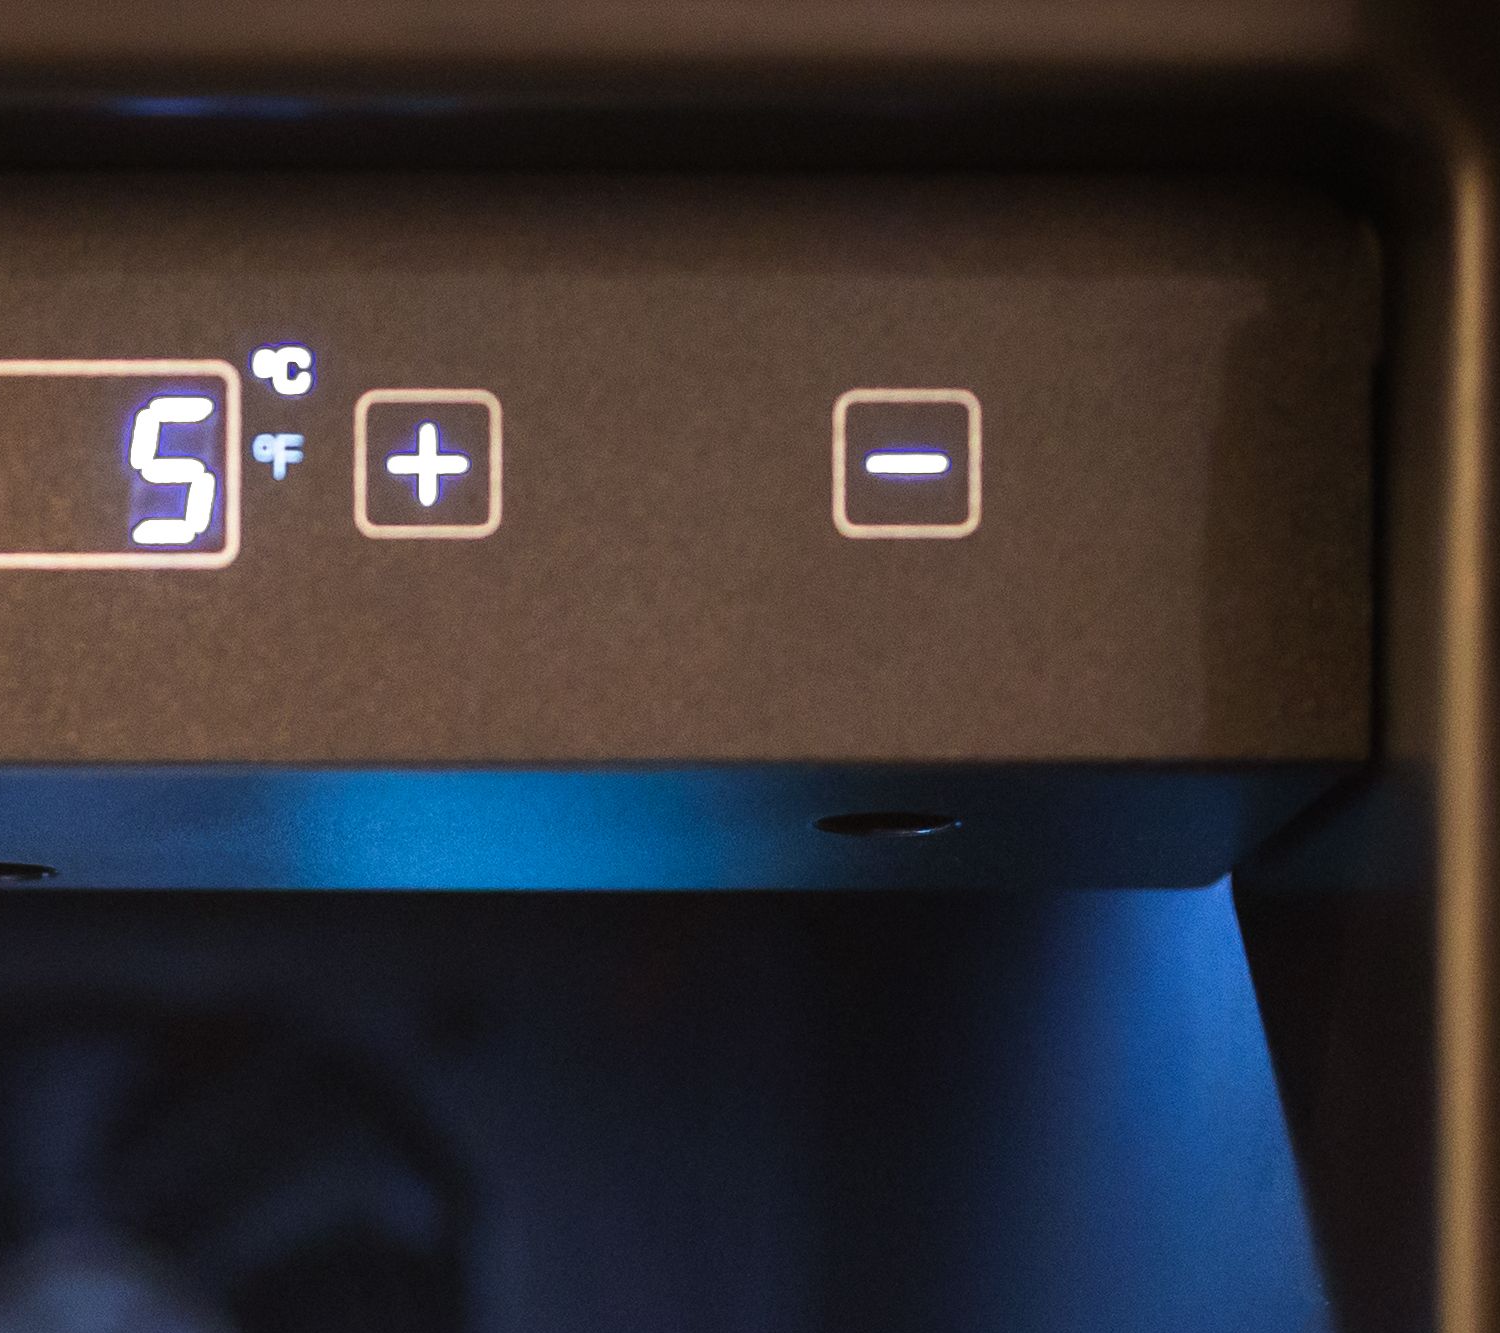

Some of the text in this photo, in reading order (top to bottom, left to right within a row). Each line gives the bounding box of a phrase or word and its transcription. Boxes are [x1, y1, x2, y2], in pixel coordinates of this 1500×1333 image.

[252, 346, 311, 395] °C
[130, 396, 215, 545] 5
[252, 433, 305, 480] °F
